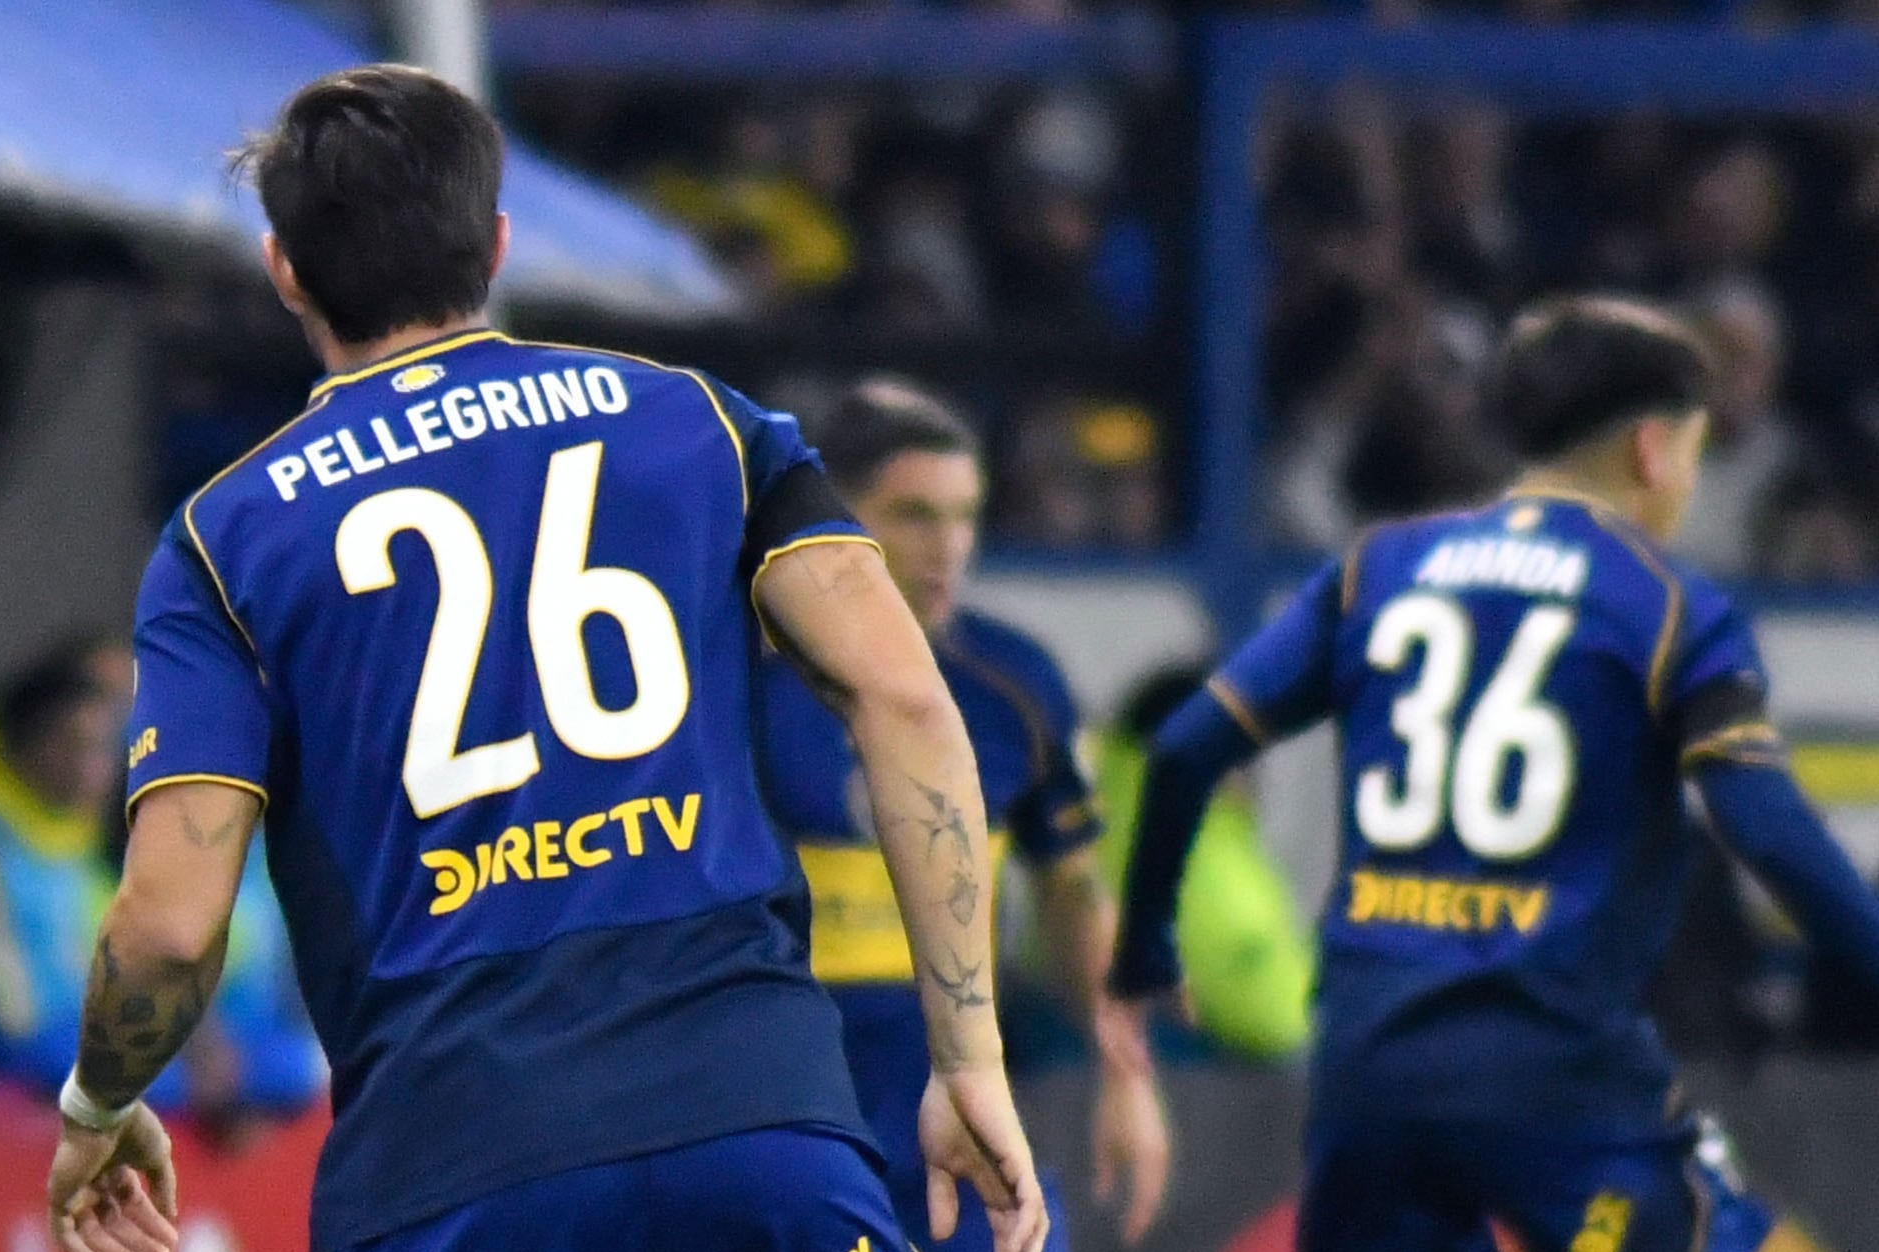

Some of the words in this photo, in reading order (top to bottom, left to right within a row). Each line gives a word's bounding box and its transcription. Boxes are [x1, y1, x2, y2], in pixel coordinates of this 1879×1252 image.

[266, 366, 629, 502] PELLEGRINO
[334, 439, 691, 820] 26
[1355, 592, 1575, 862] 36
[420, 793, 701, 916] DIRECTV
[1348, 871, 1547, 934] DIRECTV
